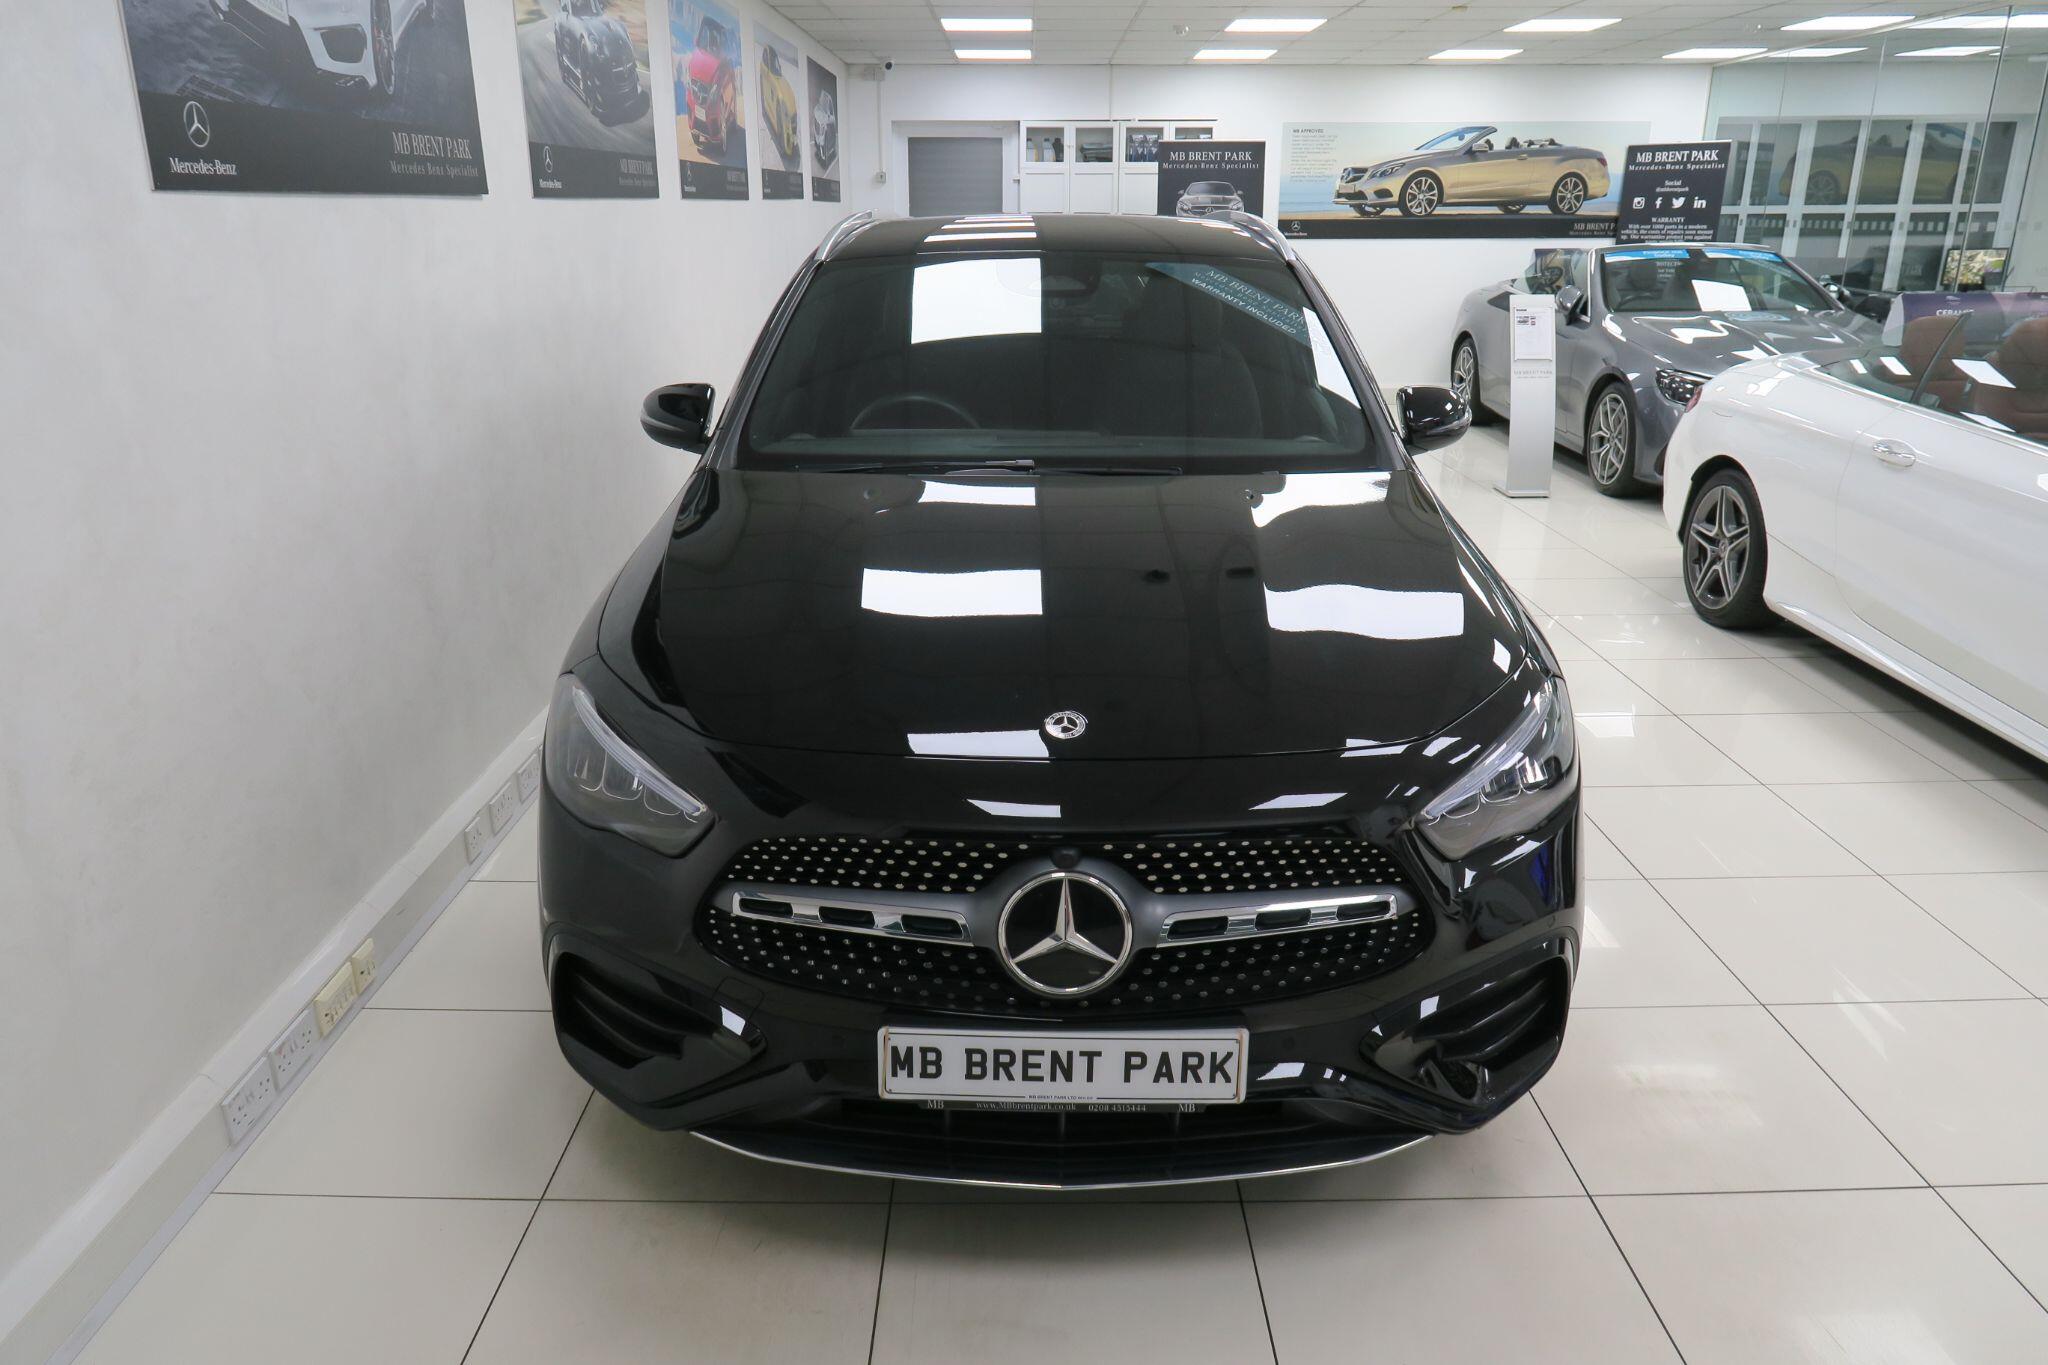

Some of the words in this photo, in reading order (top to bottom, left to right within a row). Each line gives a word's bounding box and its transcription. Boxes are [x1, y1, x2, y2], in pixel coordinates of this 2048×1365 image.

[393, 131, 410, 155] MB
[411, 133, 444, 157] BRENT
[446, 137, 472, 159] PARK
[1170, 151, 1186, 161] MB
[1189, 151, 1221, 161] BRENT
[1224, 151, 1252, 161] PARK
[1636, 152, 1652, 163] MB
[1654, 150, 1689, 162] BRENT
[1691, 149, 1719, 161] PARK
[169, 157, 237, 175] Mercedes-Benz
[390, 161, 426, 175] Mercedes
[446, 164, 479, 179] Specialist
[1628, 163, 1684, 171] Mercedes-Benz
[1574, 222, 1585, 230] MB
[1586, 222, 1609, 230] BRENT
[1191, 278, 1246, 307] WARRANTY
[1246, 305, 1297, 335] INCLUDED
[1206, 270, 1228, 284] MB
[1228, 281, 1274, 305] BRENT
[1272, 303, 1306, 325] PARK
[890, 1045, 942, 1079] MB
[964, 1048, 1102, 1083] BRENT
[1123, 1051, 1234, 1084] PARK
[927, 1100, 945, 1110] MB
[976, 1101, 1077, 1112] www.MBbrentpark.co.uk
[1088, 1104, 1109, 1112] 0208
[1178, 1103, 1196, 1113] MB
